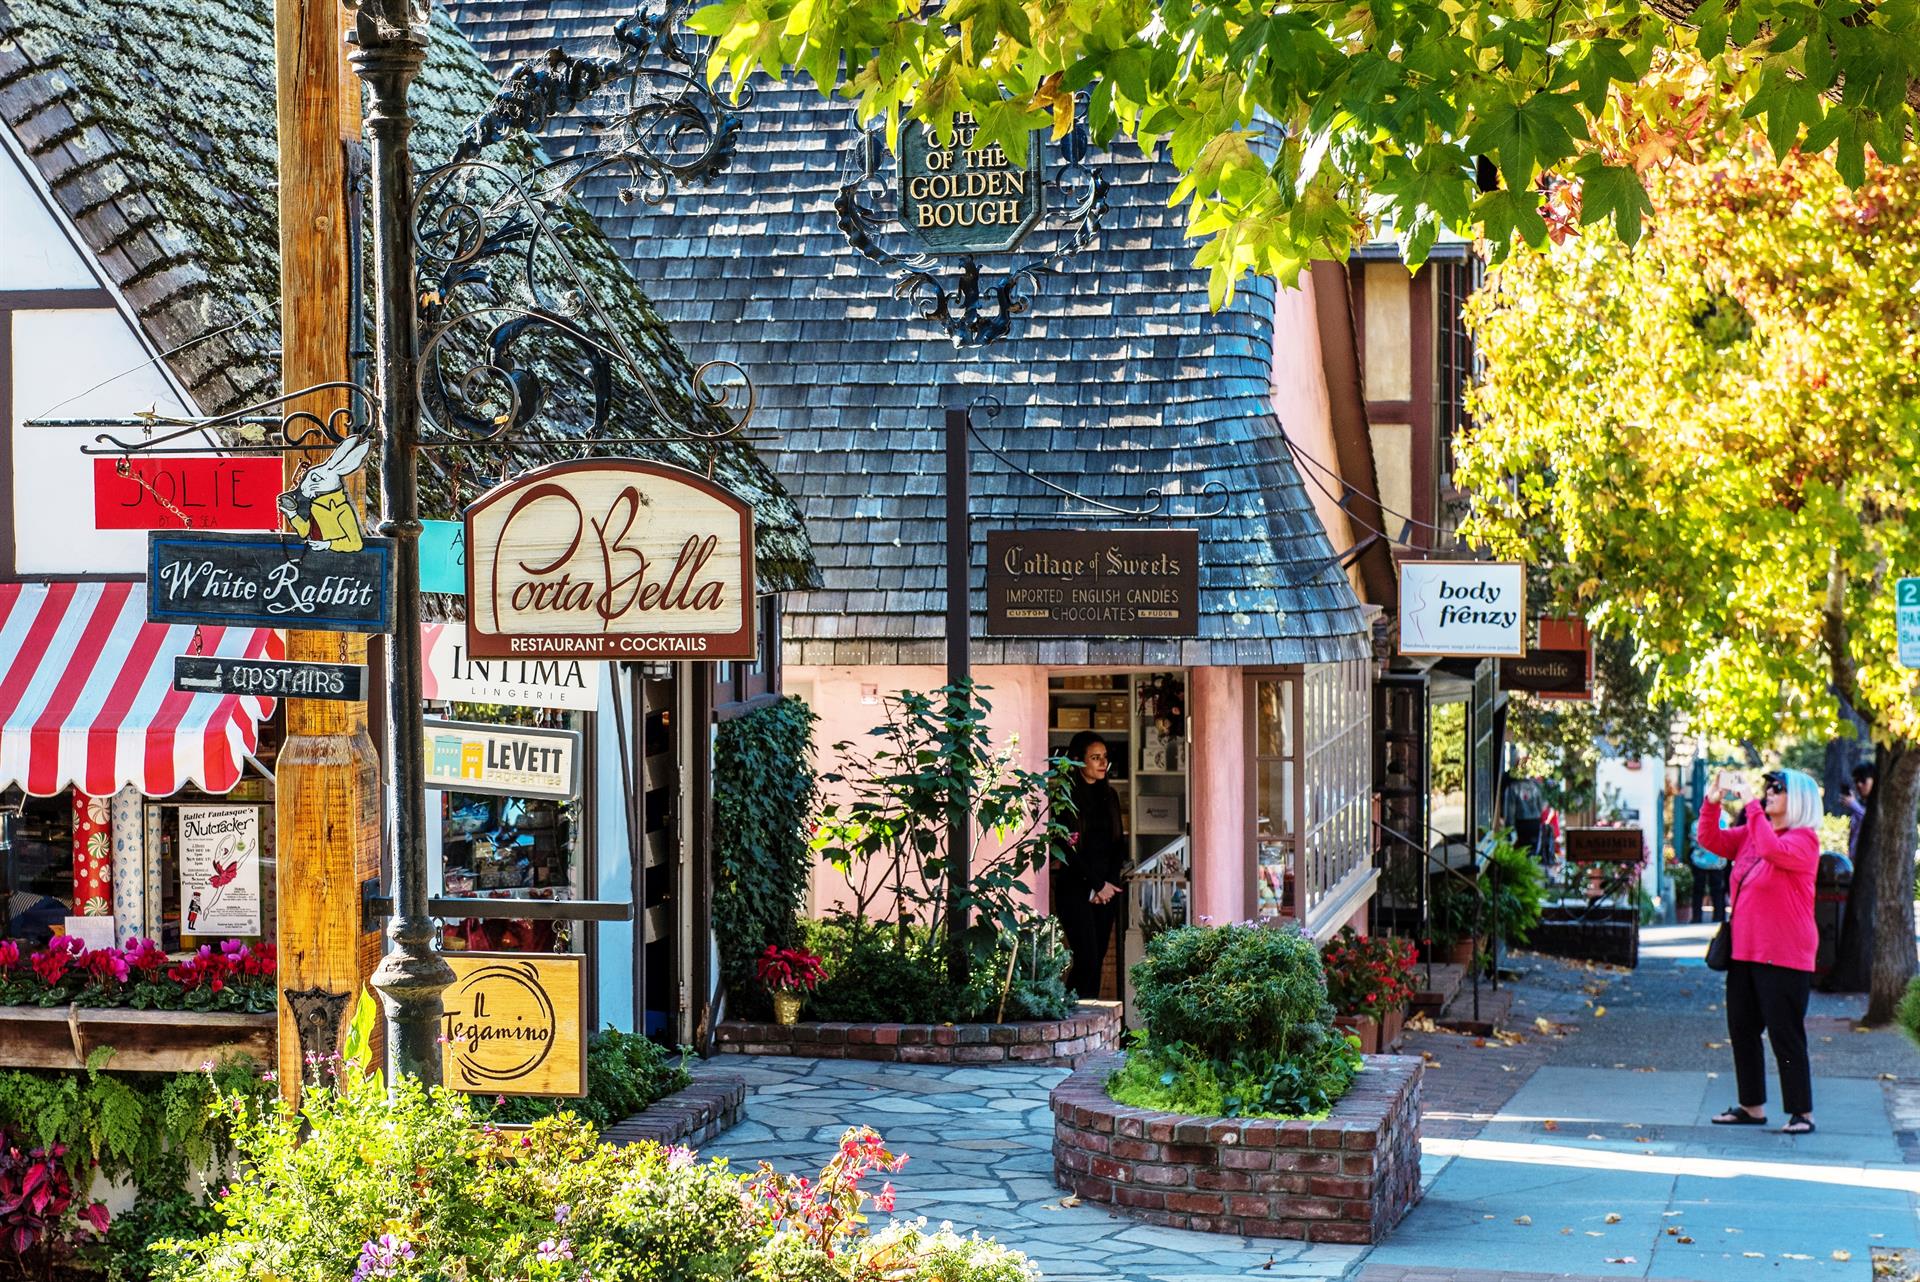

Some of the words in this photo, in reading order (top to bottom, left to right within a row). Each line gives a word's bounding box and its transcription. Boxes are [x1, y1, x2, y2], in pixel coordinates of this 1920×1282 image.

[926, 151, 954, 170] OF
[962, 149, 1008, 168] THE
[910, 171, 1025, 199] GOLDEN
[917, 200, 1020, 227] BOUGH
[1004, 546, 1085, 582] Cottage
[1089, 552, 1100, 582] of
[1106, 546, 1181, 576] Sweets
[160, 561, 257, 600] White
[263, 558, 373, 614] Rabbit
[1006, 589, 1063, 603] IMPORTED
[1072, 589, 1120, 604] ENGLISH
[1127, 589, 1179, 604] CANDIES
[1439, 580, 1501, 604] body
[1903, 583, 1918, 604] 2
[1008, 609, 1046, 617] CUSTOM
[1051, 607, 1135, 621] CHOCOLATES
[1439, 605, 1517, 629] frenzy
[511, 638, 604, 651] RESTAURANT
[620, 638, 707, 651] COCKTAILS
[232, 665, 344, 693] UPSTAIRS
[471, 686, 566, 702] LINGERIE
[184, 818, 255, 838] Nutcracker
[441, 1011, 549, 1053] Tegamino
